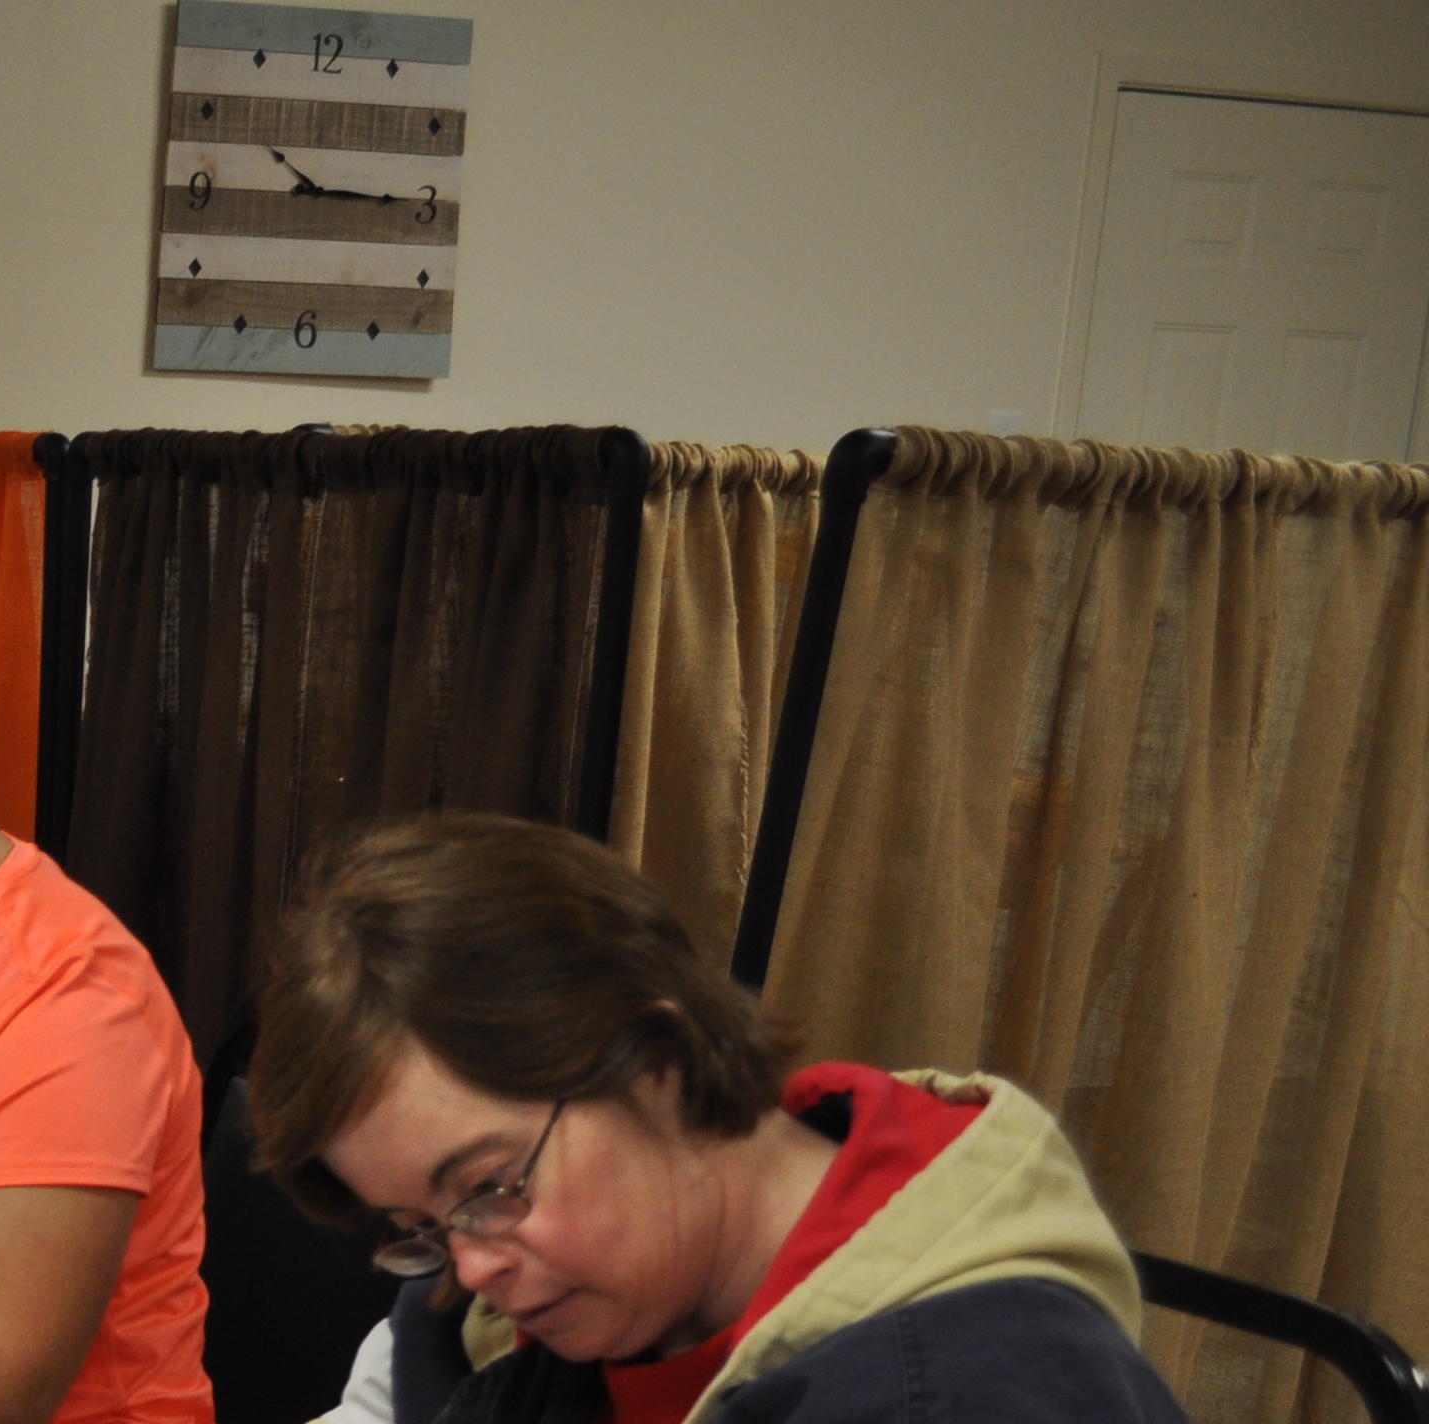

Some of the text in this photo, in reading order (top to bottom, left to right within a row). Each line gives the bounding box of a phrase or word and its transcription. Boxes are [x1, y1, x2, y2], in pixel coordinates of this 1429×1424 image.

[311, 33, 344, 74] 12
[188, 171, 212, 211] 9
[414, 185, 437, 225] 3
[294, 310, 317, 348] 6
